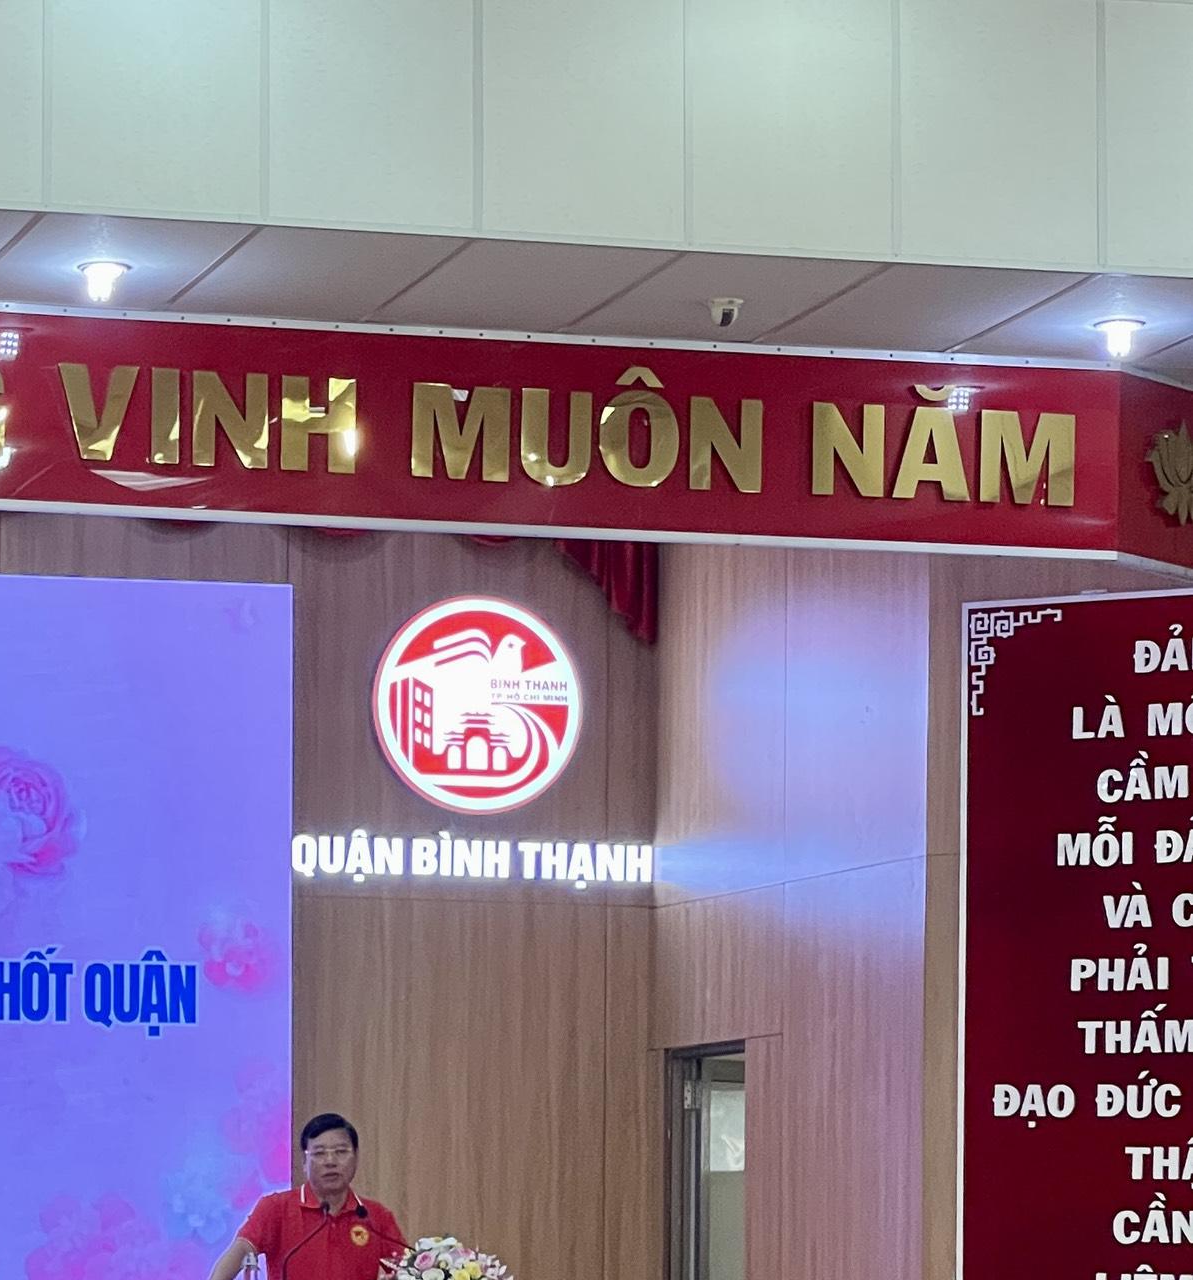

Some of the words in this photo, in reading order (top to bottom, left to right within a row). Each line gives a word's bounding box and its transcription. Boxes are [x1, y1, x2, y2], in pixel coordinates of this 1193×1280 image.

[57, 362, 358, 474] VINH
[410, 366, 764, 494] MUÔN
[811, 384, 1077, 508] NĂM
[1133, 623, 1193, 674] ĐẢ
[1072, 694, 1125, 739] LÀ
[1096, 750, 1189, 804] CẦM
[292, 829, 404, 883] QUẬN
[411, 831, 510, 879] BÌNH
[518, 841, 653, 889] THẠNH
[1056, 815, 1134, 868] MỖI
[1102, 881, 1153, 928] VÀ
[1070, 943, 1170, 991] PHẢI
[83, 950, 198, 1038] QUẬN
[1076, 1003, 1193, 1054] THẤM
[991, 1083, 1076, 1128] ĐẠO
[1094, 1069, 1182, 1119] ĐỨC
[1112, 1192, 1193, 1245] CẦN
